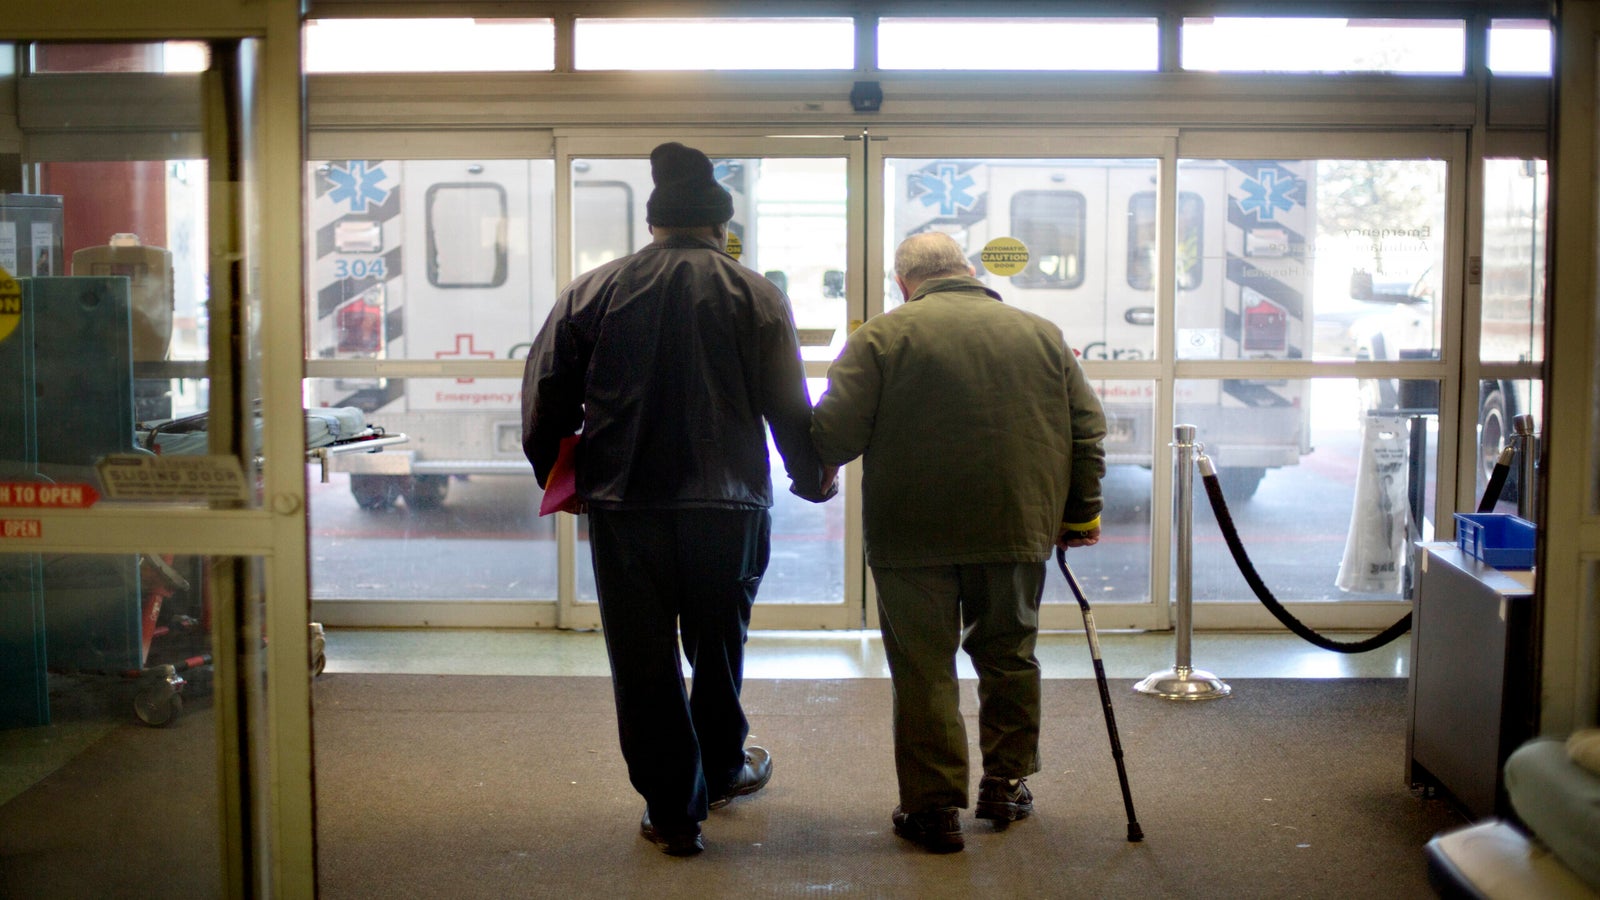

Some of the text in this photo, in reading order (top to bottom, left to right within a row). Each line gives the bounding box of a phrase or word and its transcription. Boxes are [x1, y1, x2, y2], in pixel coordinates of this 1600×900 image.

[982, 253, 1028, 261] CAUTION
[335, 259, 385, 278] 304
[1082, 341, 1154, 360] Gra
[435, 392, 513, 403] Emergency
[109, 470, 238, 481] SLIDING DOOR
[14, 486, 36, 503] TO
[39, 486, 83, 504] OPEN
[4, 520, 38, 537] OPEN
